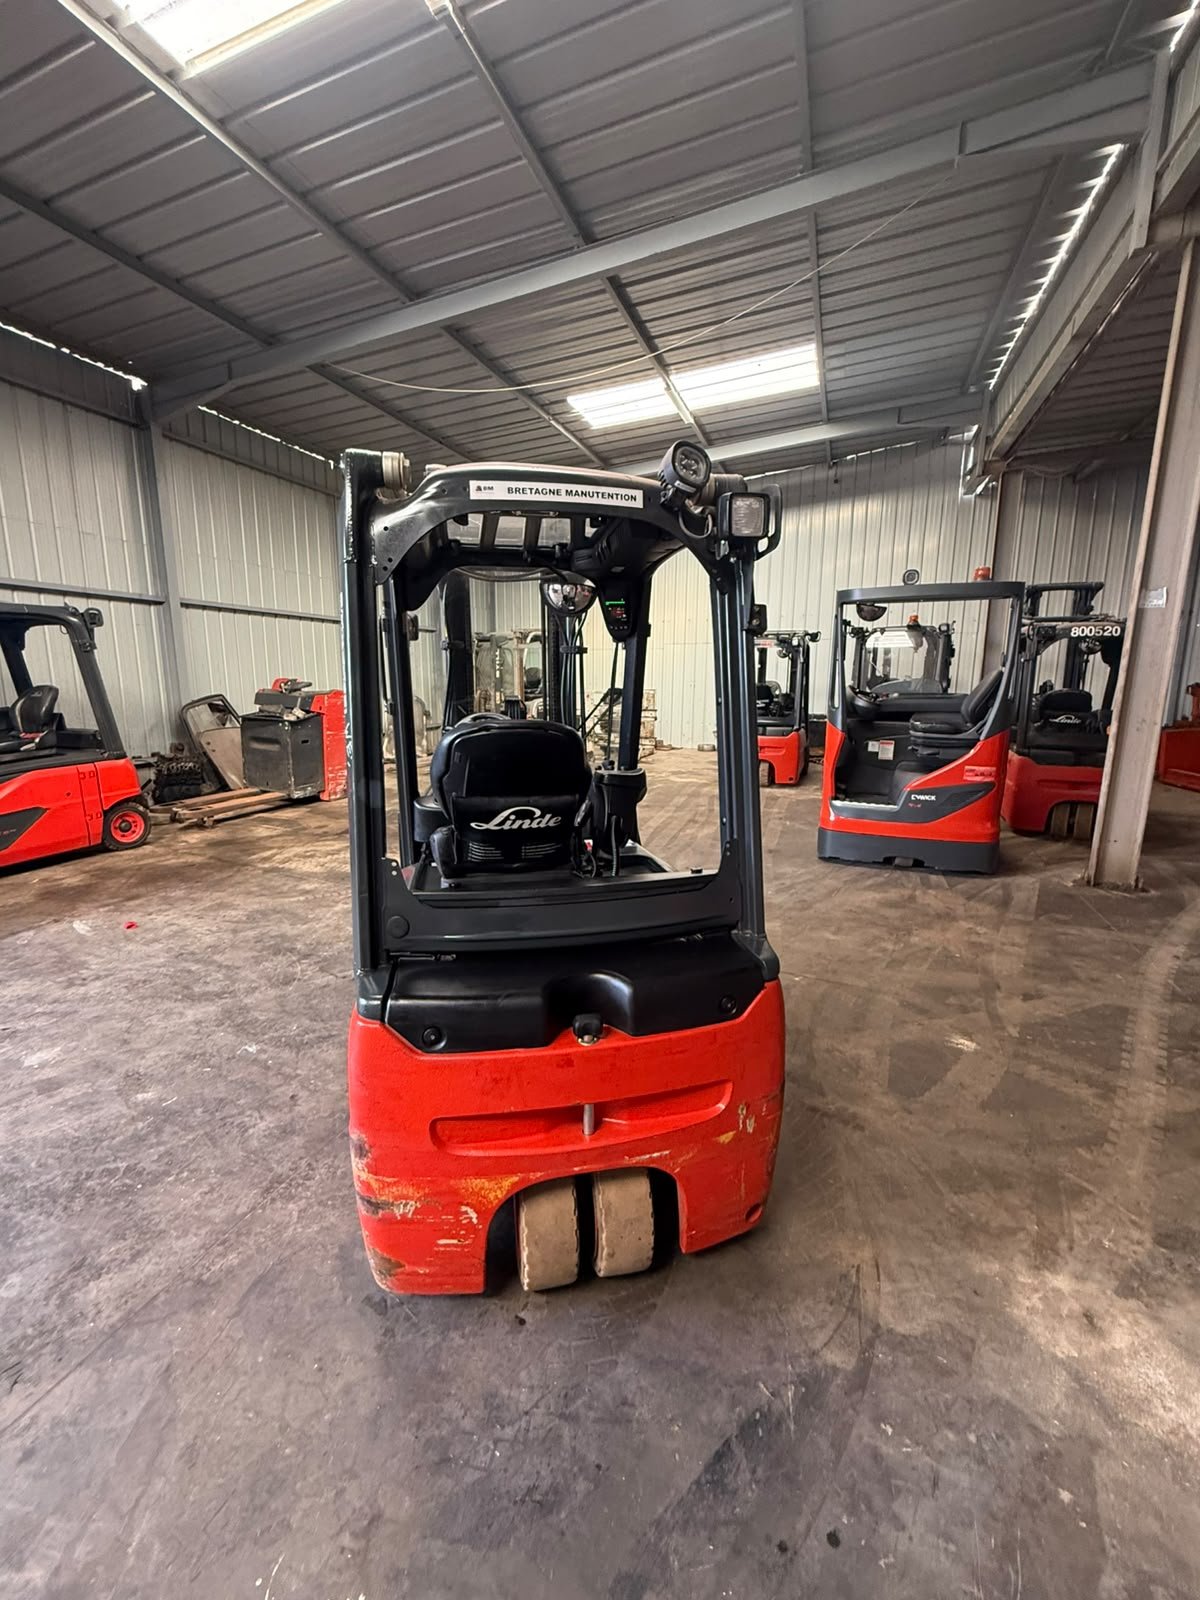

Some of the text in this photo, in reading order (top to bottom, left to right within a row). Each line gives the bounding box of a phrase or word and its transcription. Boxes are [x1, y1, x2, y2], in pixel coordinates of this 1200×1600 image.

[507, 486, 637, 502] BRETAGNE MANUTENTION
[1070, 625, 1121, 637] 800520
[470, 806, 562, 830] Linde
